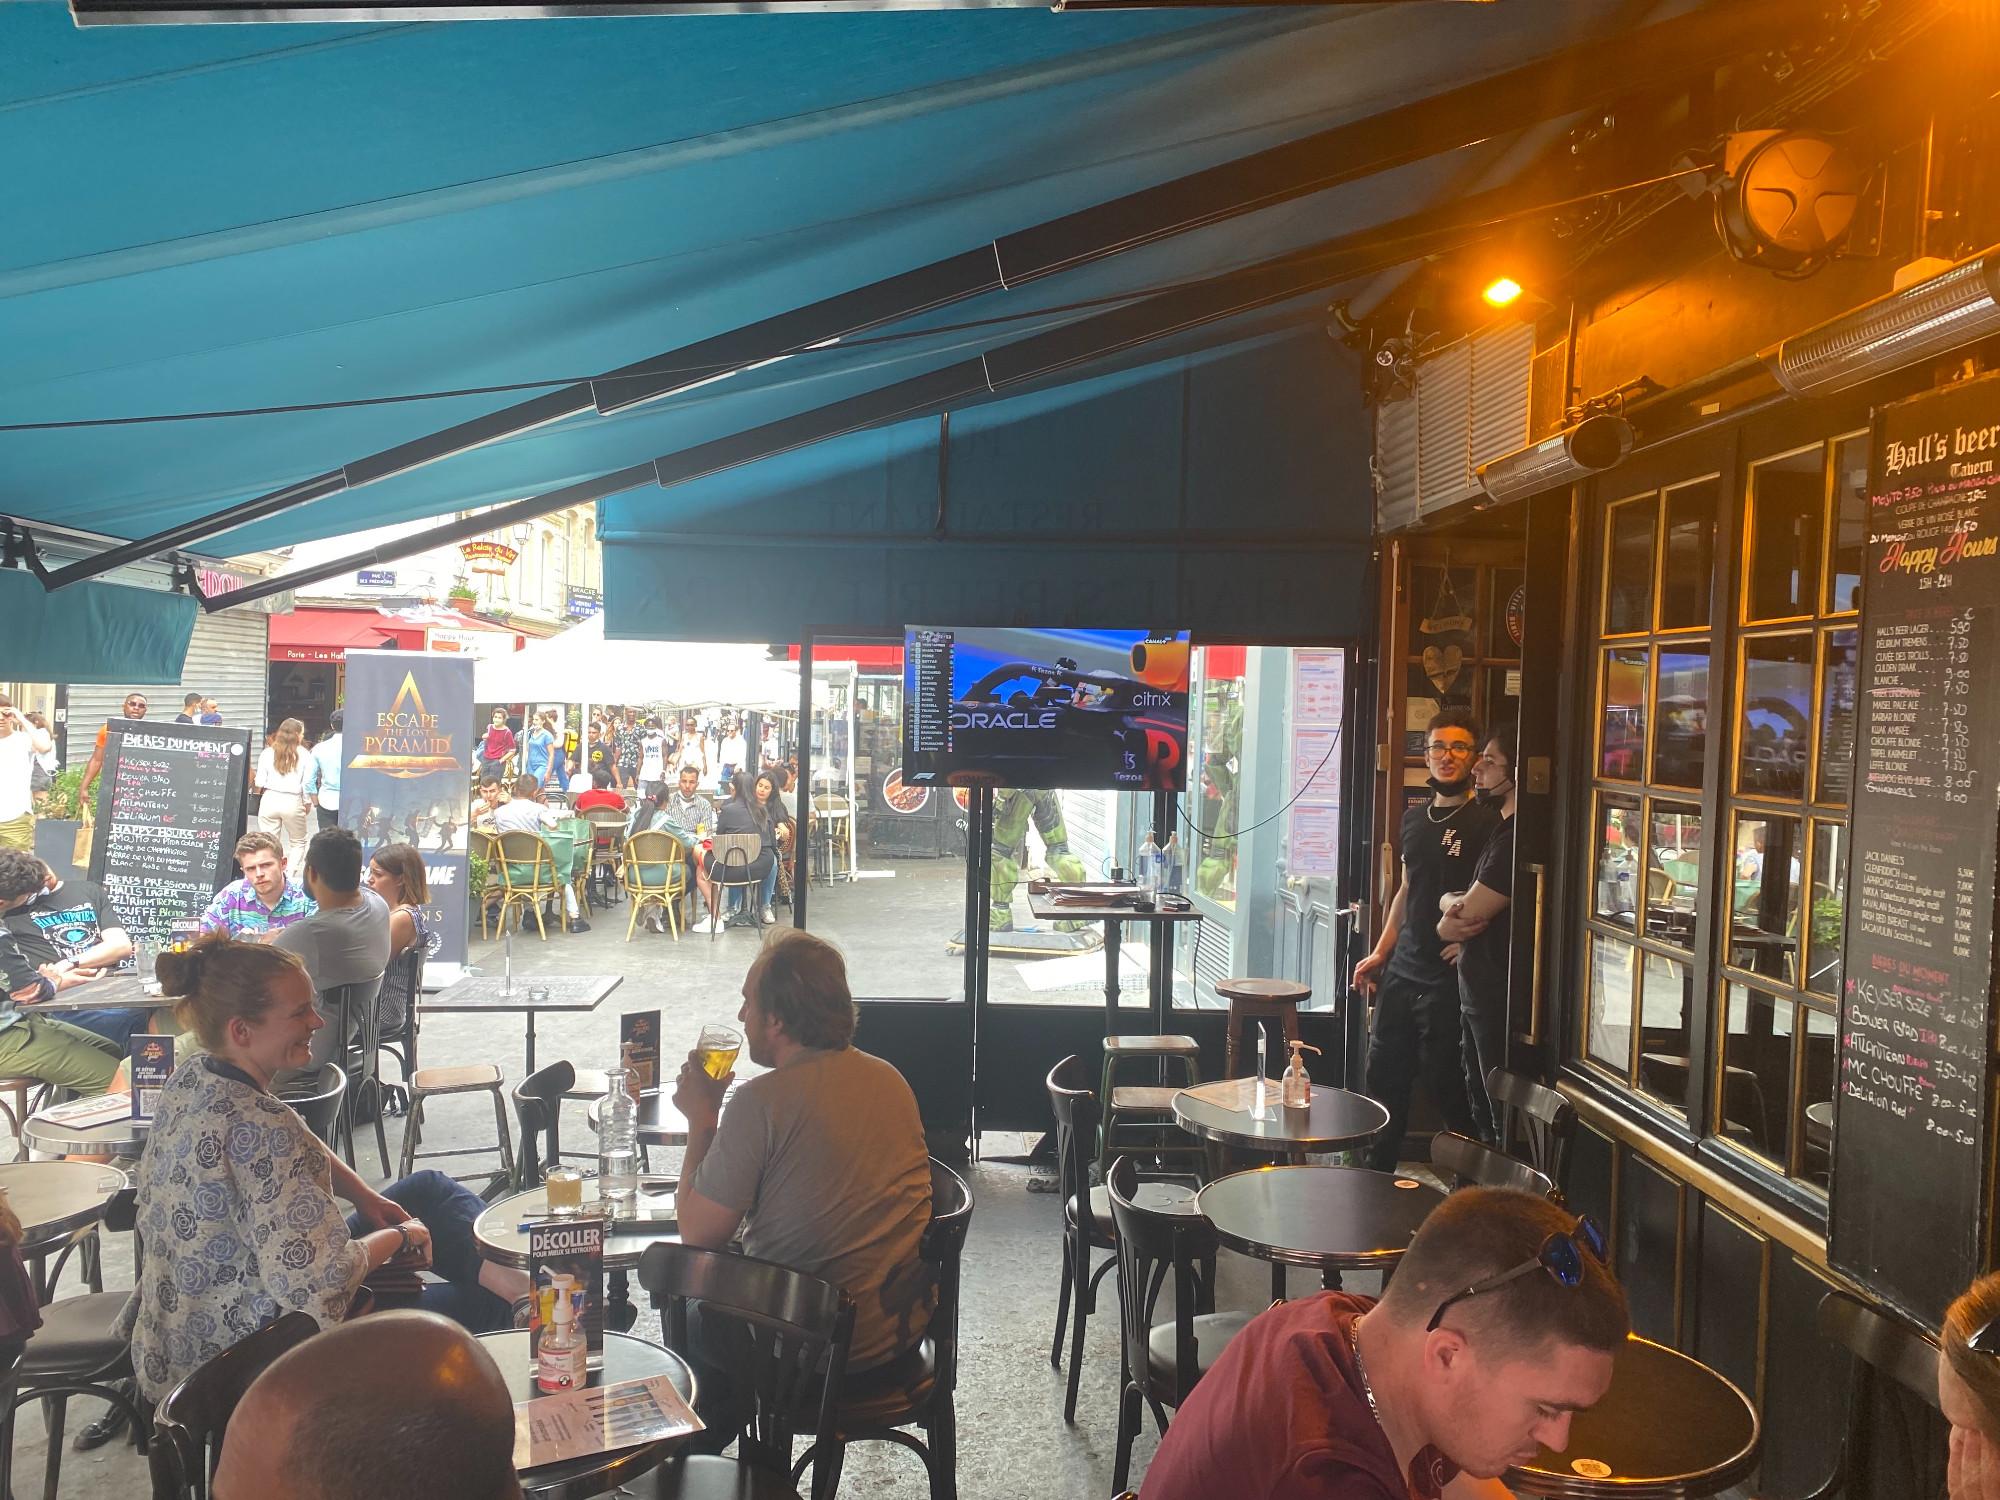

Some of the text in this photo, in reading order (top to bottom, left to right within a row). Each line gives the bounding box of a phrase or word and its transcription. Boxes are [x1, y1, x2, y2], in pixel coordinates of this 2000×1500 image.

[1886, 427, 2000, 477] Hall's beer
[1950, 461, 1993, 478] Tavern
[1896, 503, 1917, 515] COUPE
[1917, 501, 1927, 512] DE
[1898, 518, 1915, 531] VERRE
[1916, 516, 1925, 527] DE
[1926, 513, 1937, 525] VIN
[1957, 507, 1980, 520] BLANC
[1916, 528, 1940, 539] ROUGE
[1879, 532, 1998, 574] Happy Hours
[1895, 625, 1909, 635] BEER
[1910, 624, 1930, 634] LAGER
[1902, 637, 1928, 647] TREMENS
[287, 650, 305, 658] Paris
[315, 651, 329, 659] Les
[1875, 650, 1895, 662] CUVÉE
[1896, 651, 1907, 661] DES
[1908, 651, 1930, 661] TROLLS
[1875, 664, 1897, 673] GULDEN
[1898, 663, 1917, 673] DRAAK
[1874, 675, 1899, 686] BLANCHE
[1132, 691, 1171, 707] citrix
[1872, 701, 1891, 711] MAISEL
[1893, 701, 1907, 711] PALE
[1908, 701, 1919, 711] ALE
[377, 712, 438, 729] ESCAPE
[952, 712, 1056, 729] ORACLE
[1872, 712, 1893, 722] BARBAR
[1894, 712, 1918, 723] BLONDE
[385, 728, 431, 737] THE LOST
[1871, 725, 1887, 735] KWAK
[364, 736, 451, 754] PYRAMID
[1870, 736, 1897, 747] CHOUFFE
[1898, 738, 1922, 748] BLONDE
[1869, 760, 1910, 772] LEFFE BLONDE
[1863, 851, 1880, 862] JACK
[1880, 852, 1905, 866] DANIEL'S
[1864, 863, 1901, 878] GLENFIDDICH
[1862, 886, 1879, 898] NIKKA
[1895, 880, 1915, 893] Scotch
[145, 888, 179, 900] LAGER
[1862, 897, 1887, 912] KAVALAN
[1876, 912, 1888, 924] RED
[1888, 915, 1911, 930] BREAST
[1894, 929, 1915, 944] Scotch
[532, 1228, 601, 1252] DÉCOLLER
[532, 1245, 601, 1259] POUR MIEUX SE RETROUVER
